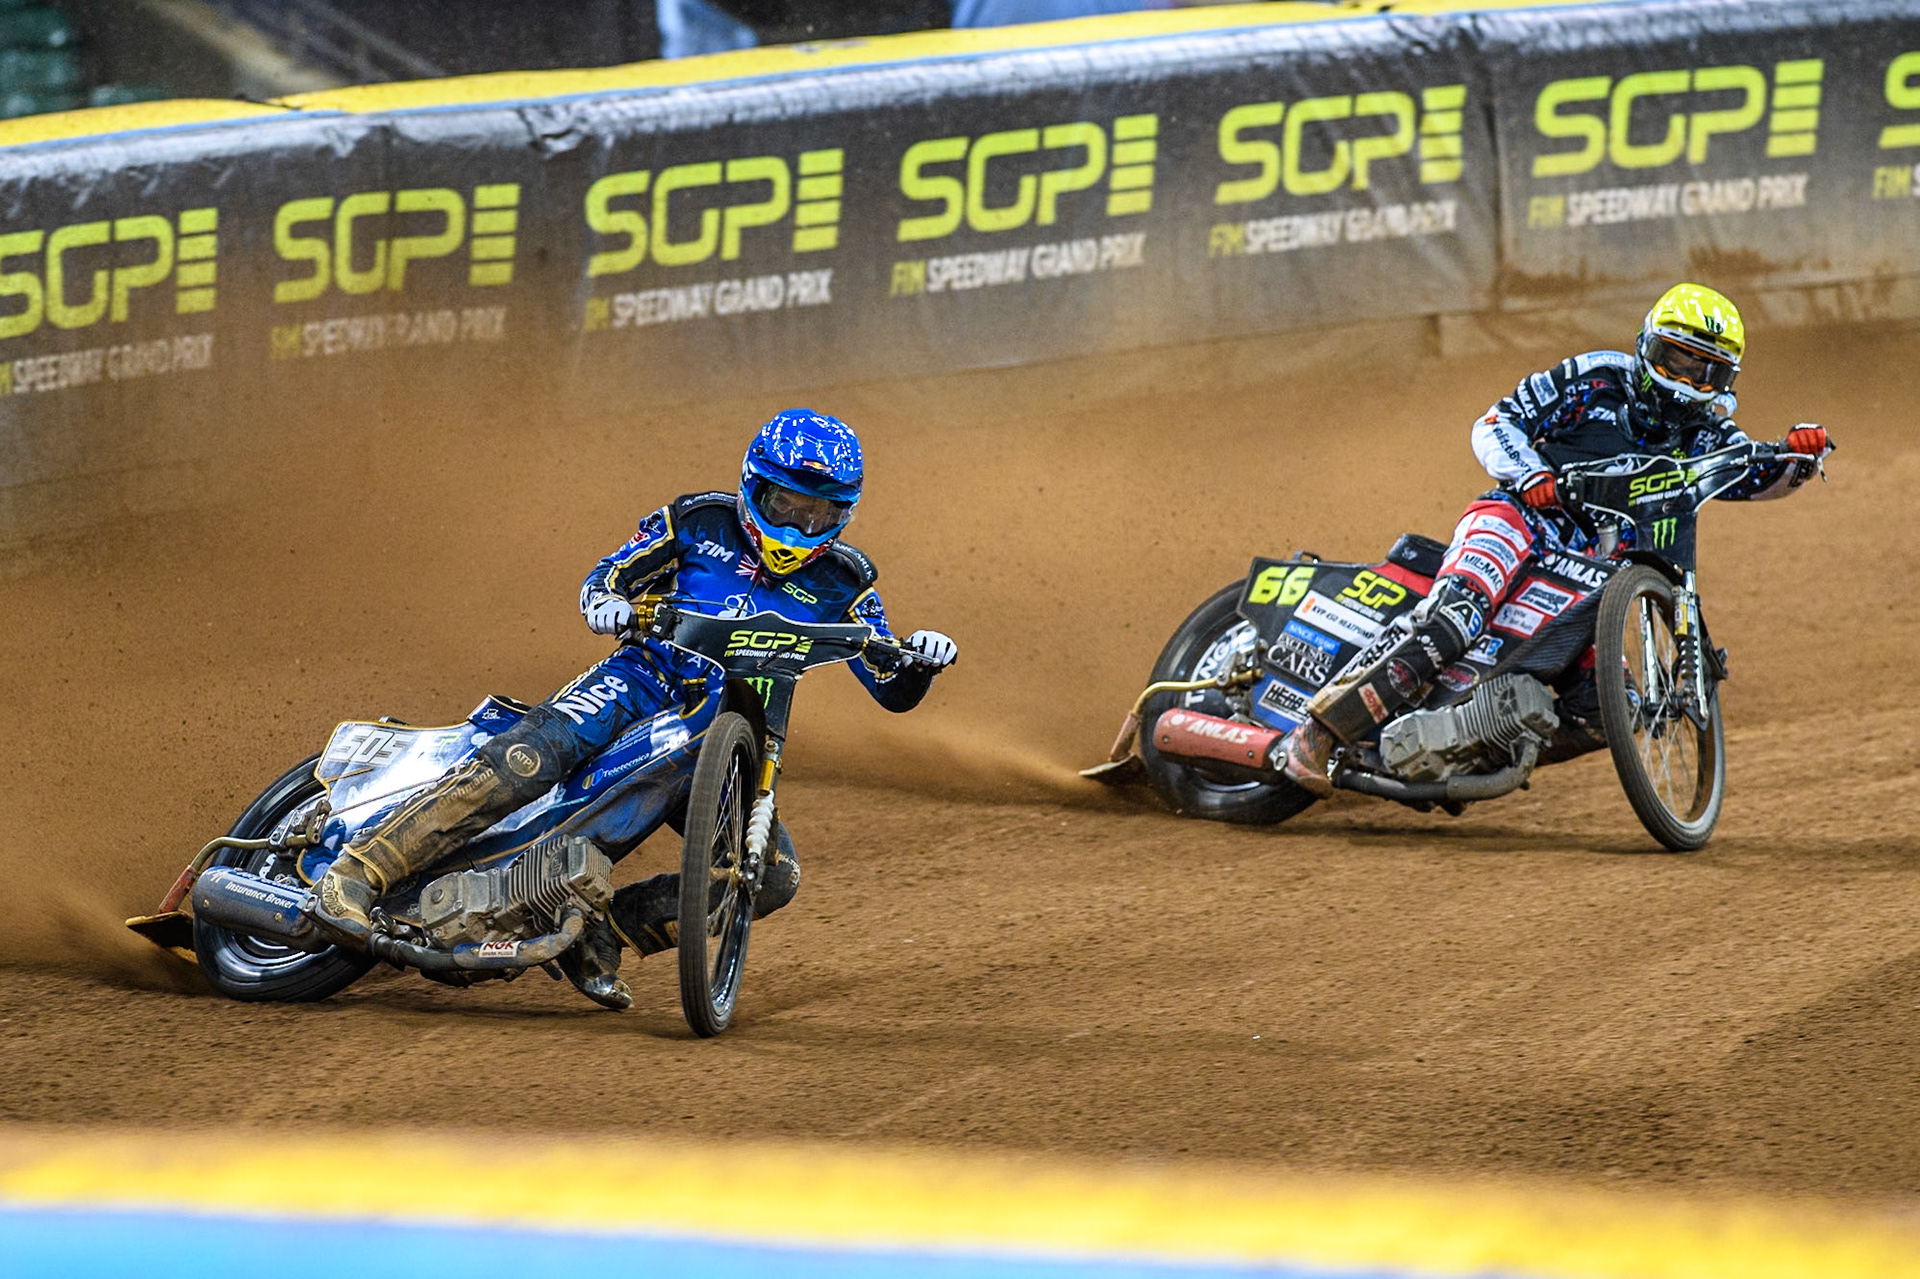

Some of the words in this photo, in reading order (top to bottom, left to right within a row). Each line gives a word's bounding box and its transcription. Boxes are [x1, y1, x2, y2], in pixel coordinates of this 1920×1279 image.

[1567, 184, 1680, 227] SPEEDWAY
[1681, 178, 1756, 216] GRAND
[1757, 173, 1808, 210] PRIX
[1245, 210, 1344, 255] SPEEDWAY
[926, 247, 1030, 293] SPEEDWAY
[1031, 238, 1098, 280] GRAND
[1100, 231, 1147, 270] PRIX
[612, 283, 714, 328] SPEEDWAY
[715, 273, 785, 316] GRAND
[786, 268, 834, 308] PRIX
[695, 540, 735, 563] FIM
[782, 581, 818, 605] SGP
[1249, 565, 1317, 606] 66
[1342, 570, 1407, 609] SGP
[1553, 558, 1608, 588] ANLAS
[735, 648, 768, 658] SPEEDWAY
[1267, 644, 1329, 685] CARS
[553, 675, 628, 725] Nice
[328, 728, 415, 768] 505
[1186, 720, 1254, 744] ANLAS
[225, 881, 264, 901] Insurance
[264, 891, 295, 909] Broker
